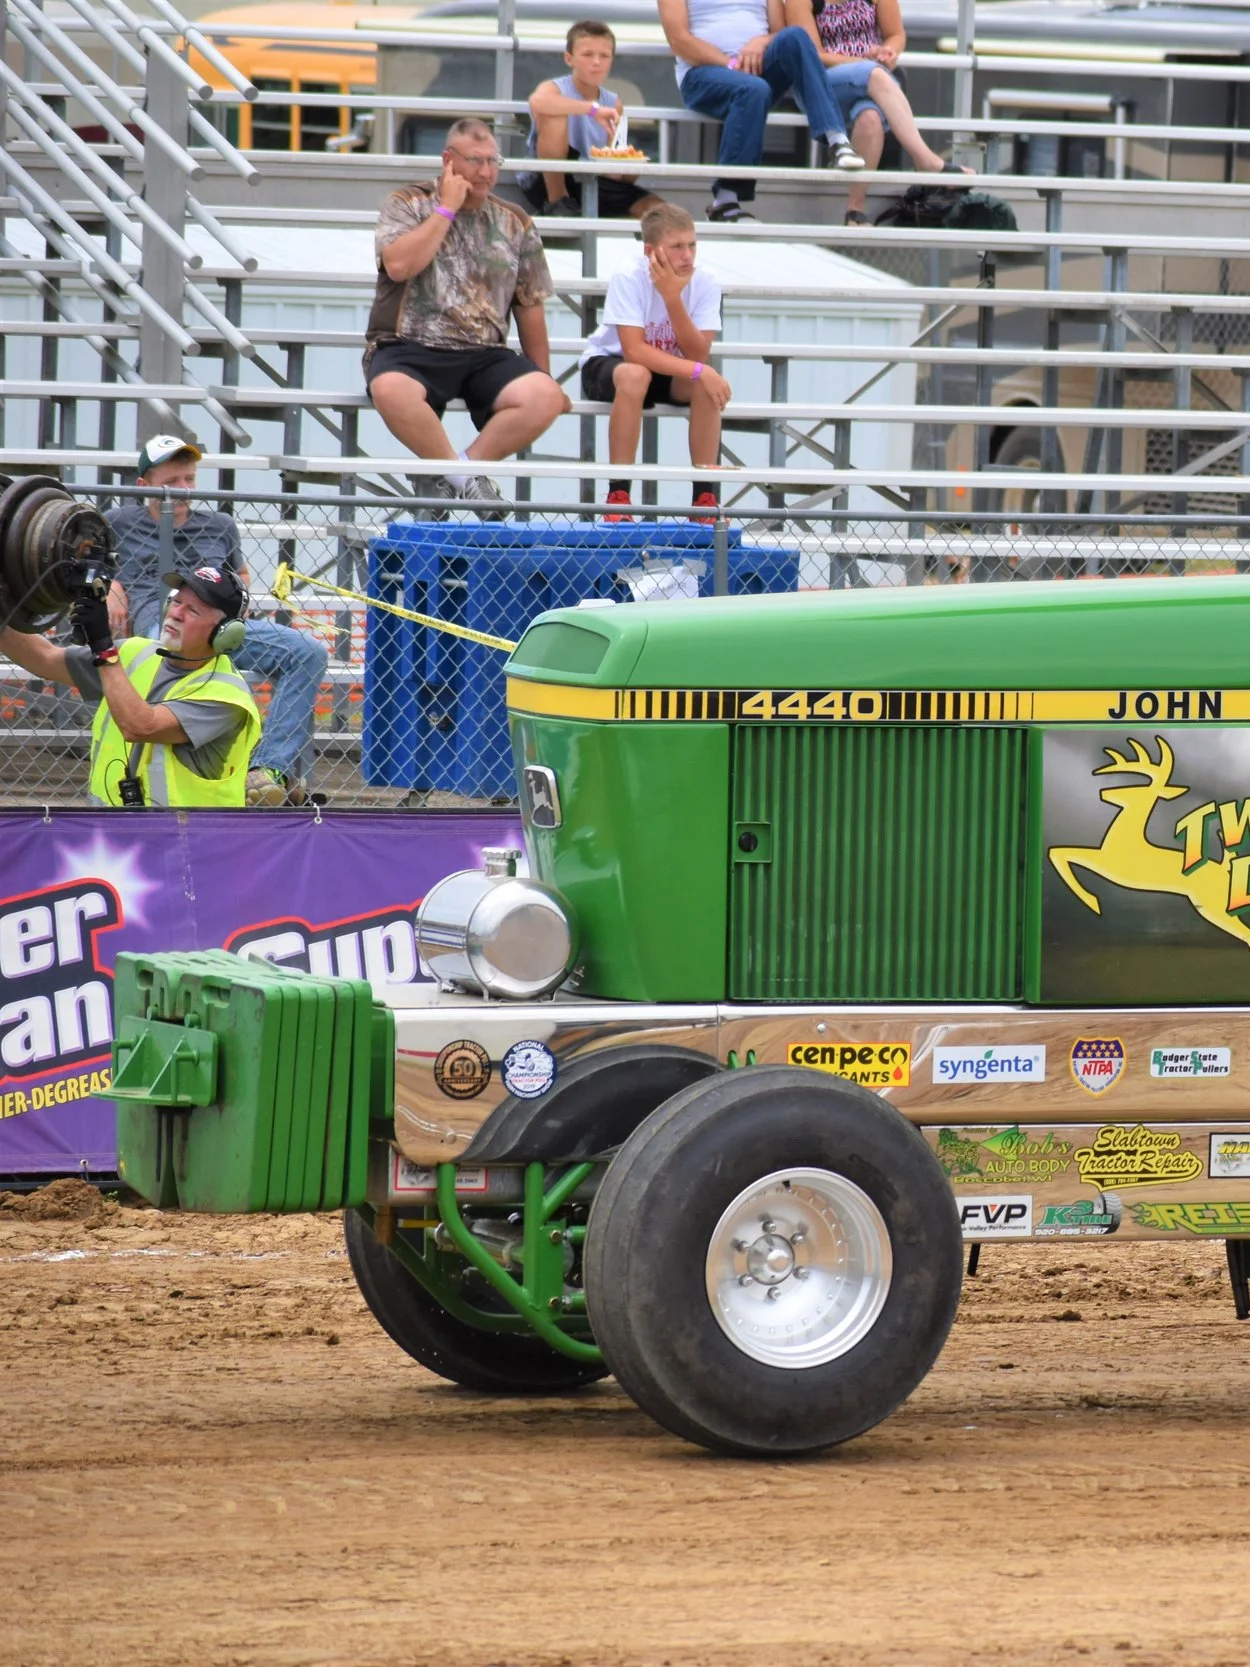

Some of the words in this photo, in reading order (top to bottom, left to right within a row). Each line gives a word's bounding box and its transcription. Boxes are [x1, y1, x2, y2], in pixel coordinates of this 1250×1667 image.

[741, 690, 882, 720] 4440
[1108, 690, 1223, 720] JOHN
[512, 1041, 545, 1052] NATIONAL
[1152, 1051, 1190, 1064] Badger
[1190, 1051, 1218, 1063] State
[453, 1059, 475, 1077] 50
[939, 1056, 1033, 1080] syngenta
[1082, 1060, 1113, 1076] NTPA
[1157, 1062, 1193, 1075] Tractor
[1191, 1061, 1229, 1074] Pullers
[0, 1068, 112, 1119] ER-DEGREAS
[1097, 1127, 1178, 1149] Slabtown
[985, 1160, 1025, 1173] AUTO
[1029, 1159, 1070, 1172] BODY
[1077, 1150, 1136, 1173] Tractor
[1139, 1150, 1195, 1173] Repair
[961, 1203, 1027, 1224] FVP
[1071, 1214, 1113, 1225] TIRE
